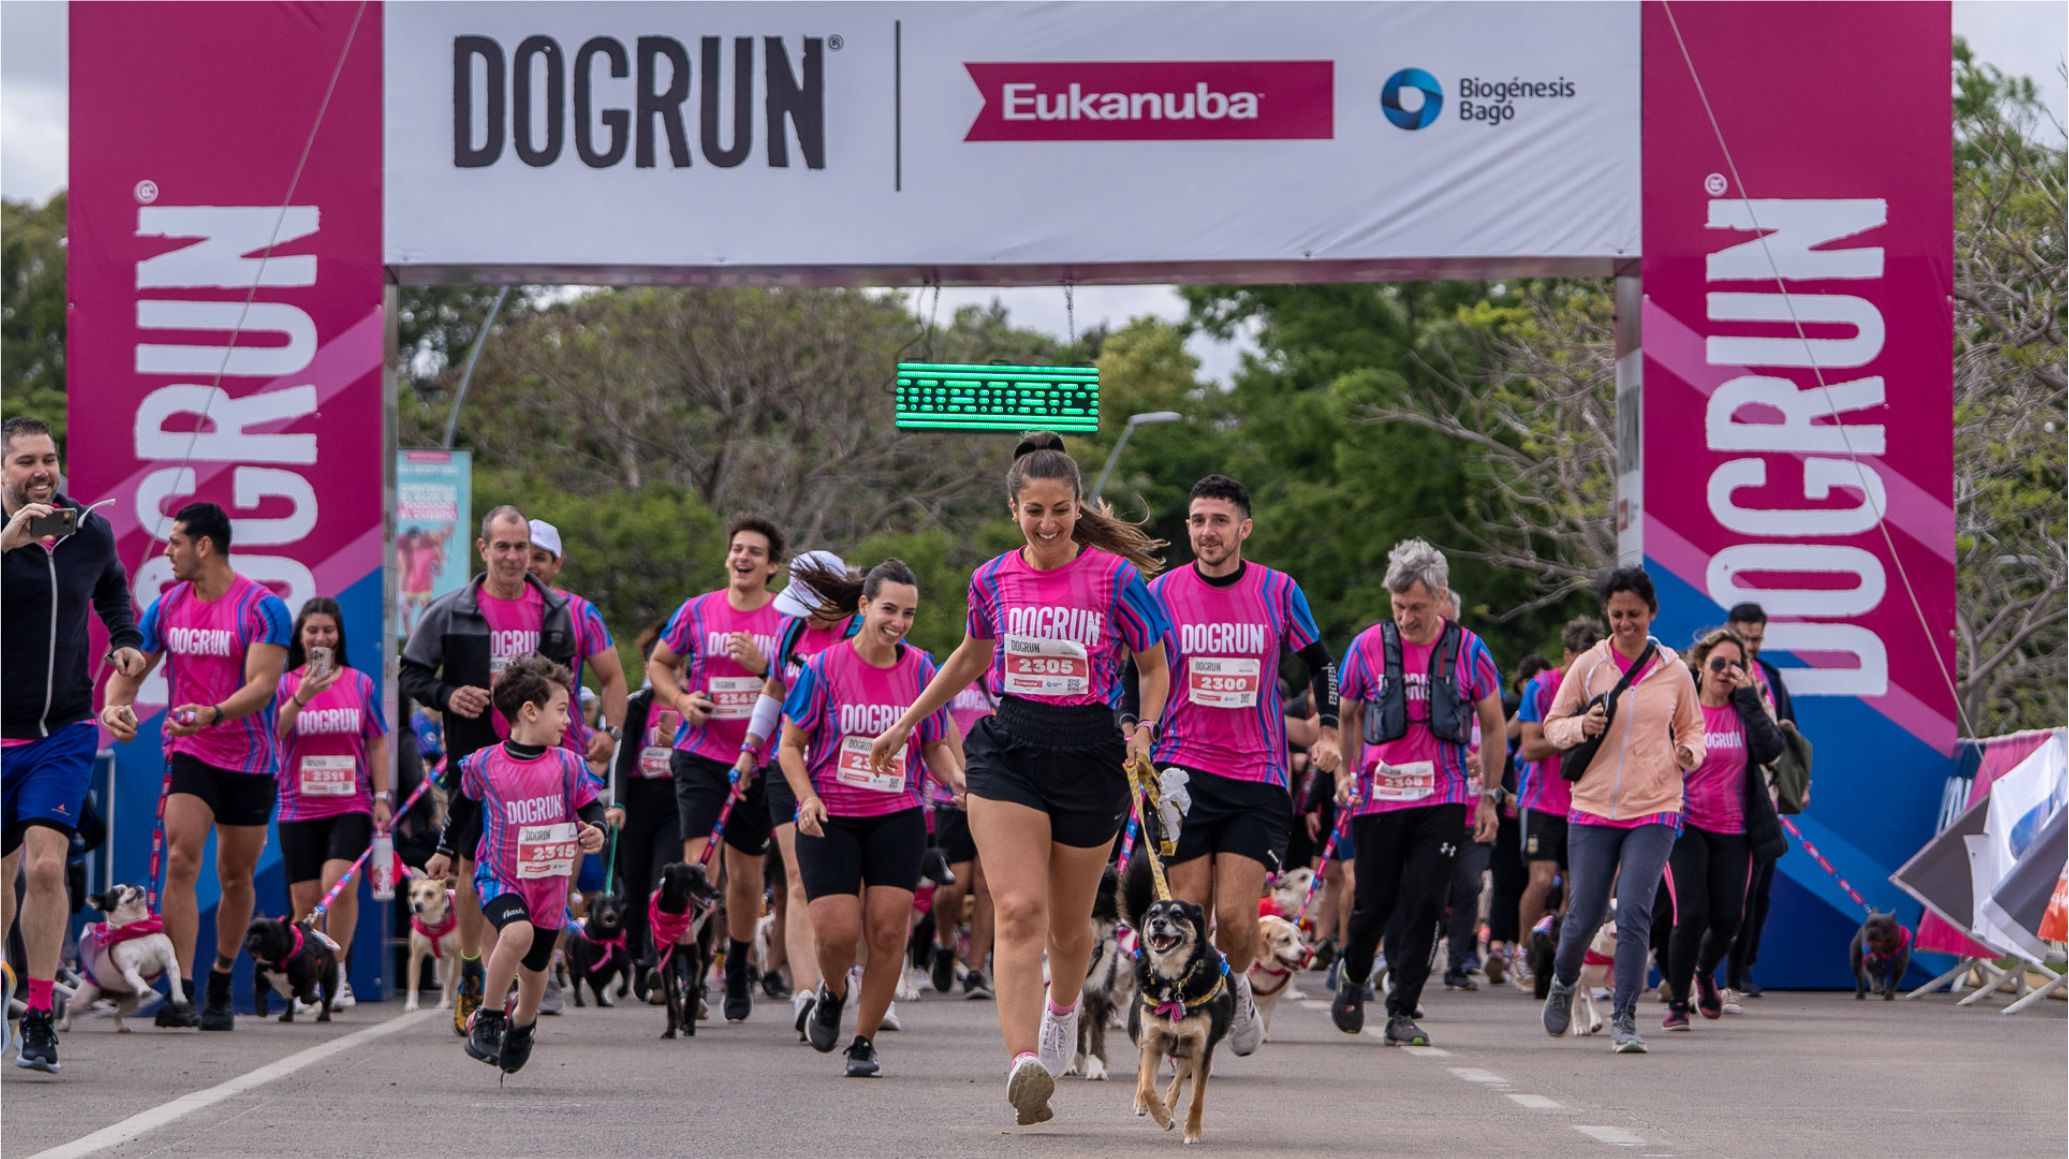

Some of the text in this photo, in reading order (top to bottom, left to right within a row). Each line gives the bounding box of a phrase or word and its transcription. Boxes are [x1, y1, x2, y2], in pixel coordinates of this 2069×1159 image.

[1003, 82, 1258, 120] Eukanuba
[1460, 76, 1576, 103] Biogénesis
[1460, 100, 1515, 126] Bagó
[1009, 606, 1104, 647] DOGRUN
[1181, 622, 1264, 654] DOGRUN
[169, 627, 231, 657] DOGRUN
[1019, 658, 1073, 674] 2305
[1201, 677, 1247, 691] 2300
[298, 708, 360, 735] DOGRUN
[1704, 731, 1743, 749] OGRUN
[506, 794, 563, 825] DOGRUN
[533, 843, 576, 861] 2315
